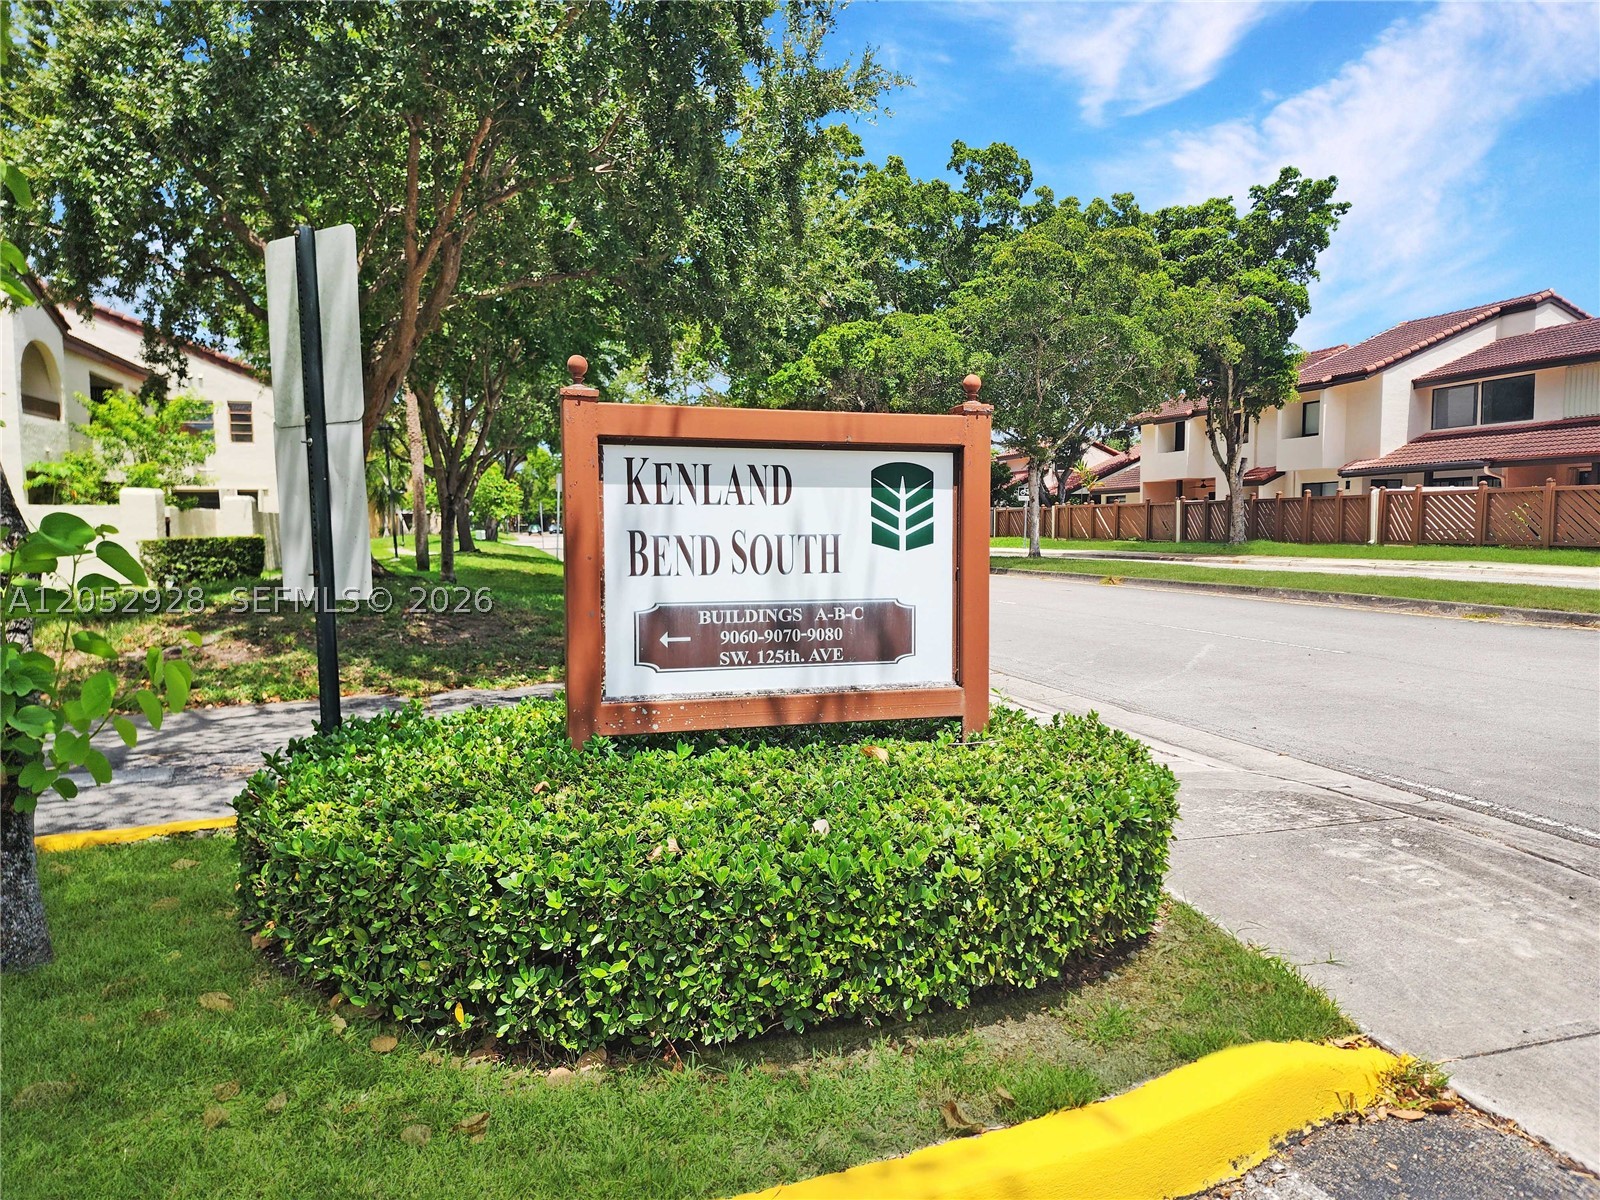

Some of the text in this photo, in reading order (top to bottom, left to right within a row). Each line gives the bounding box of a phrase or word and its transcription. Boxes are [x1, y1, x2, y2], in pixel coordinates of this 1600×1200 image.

[624, 457, 793, 505] KENLAND
[627, 529, 842, 577] BEND SOUTH
[698, 606, 864, 625] BUILDINGS A-B-C
[720, 627, 844, 645] 9060-9070-9080
[719, 647, 844, 666] SW. 125th. AVE
